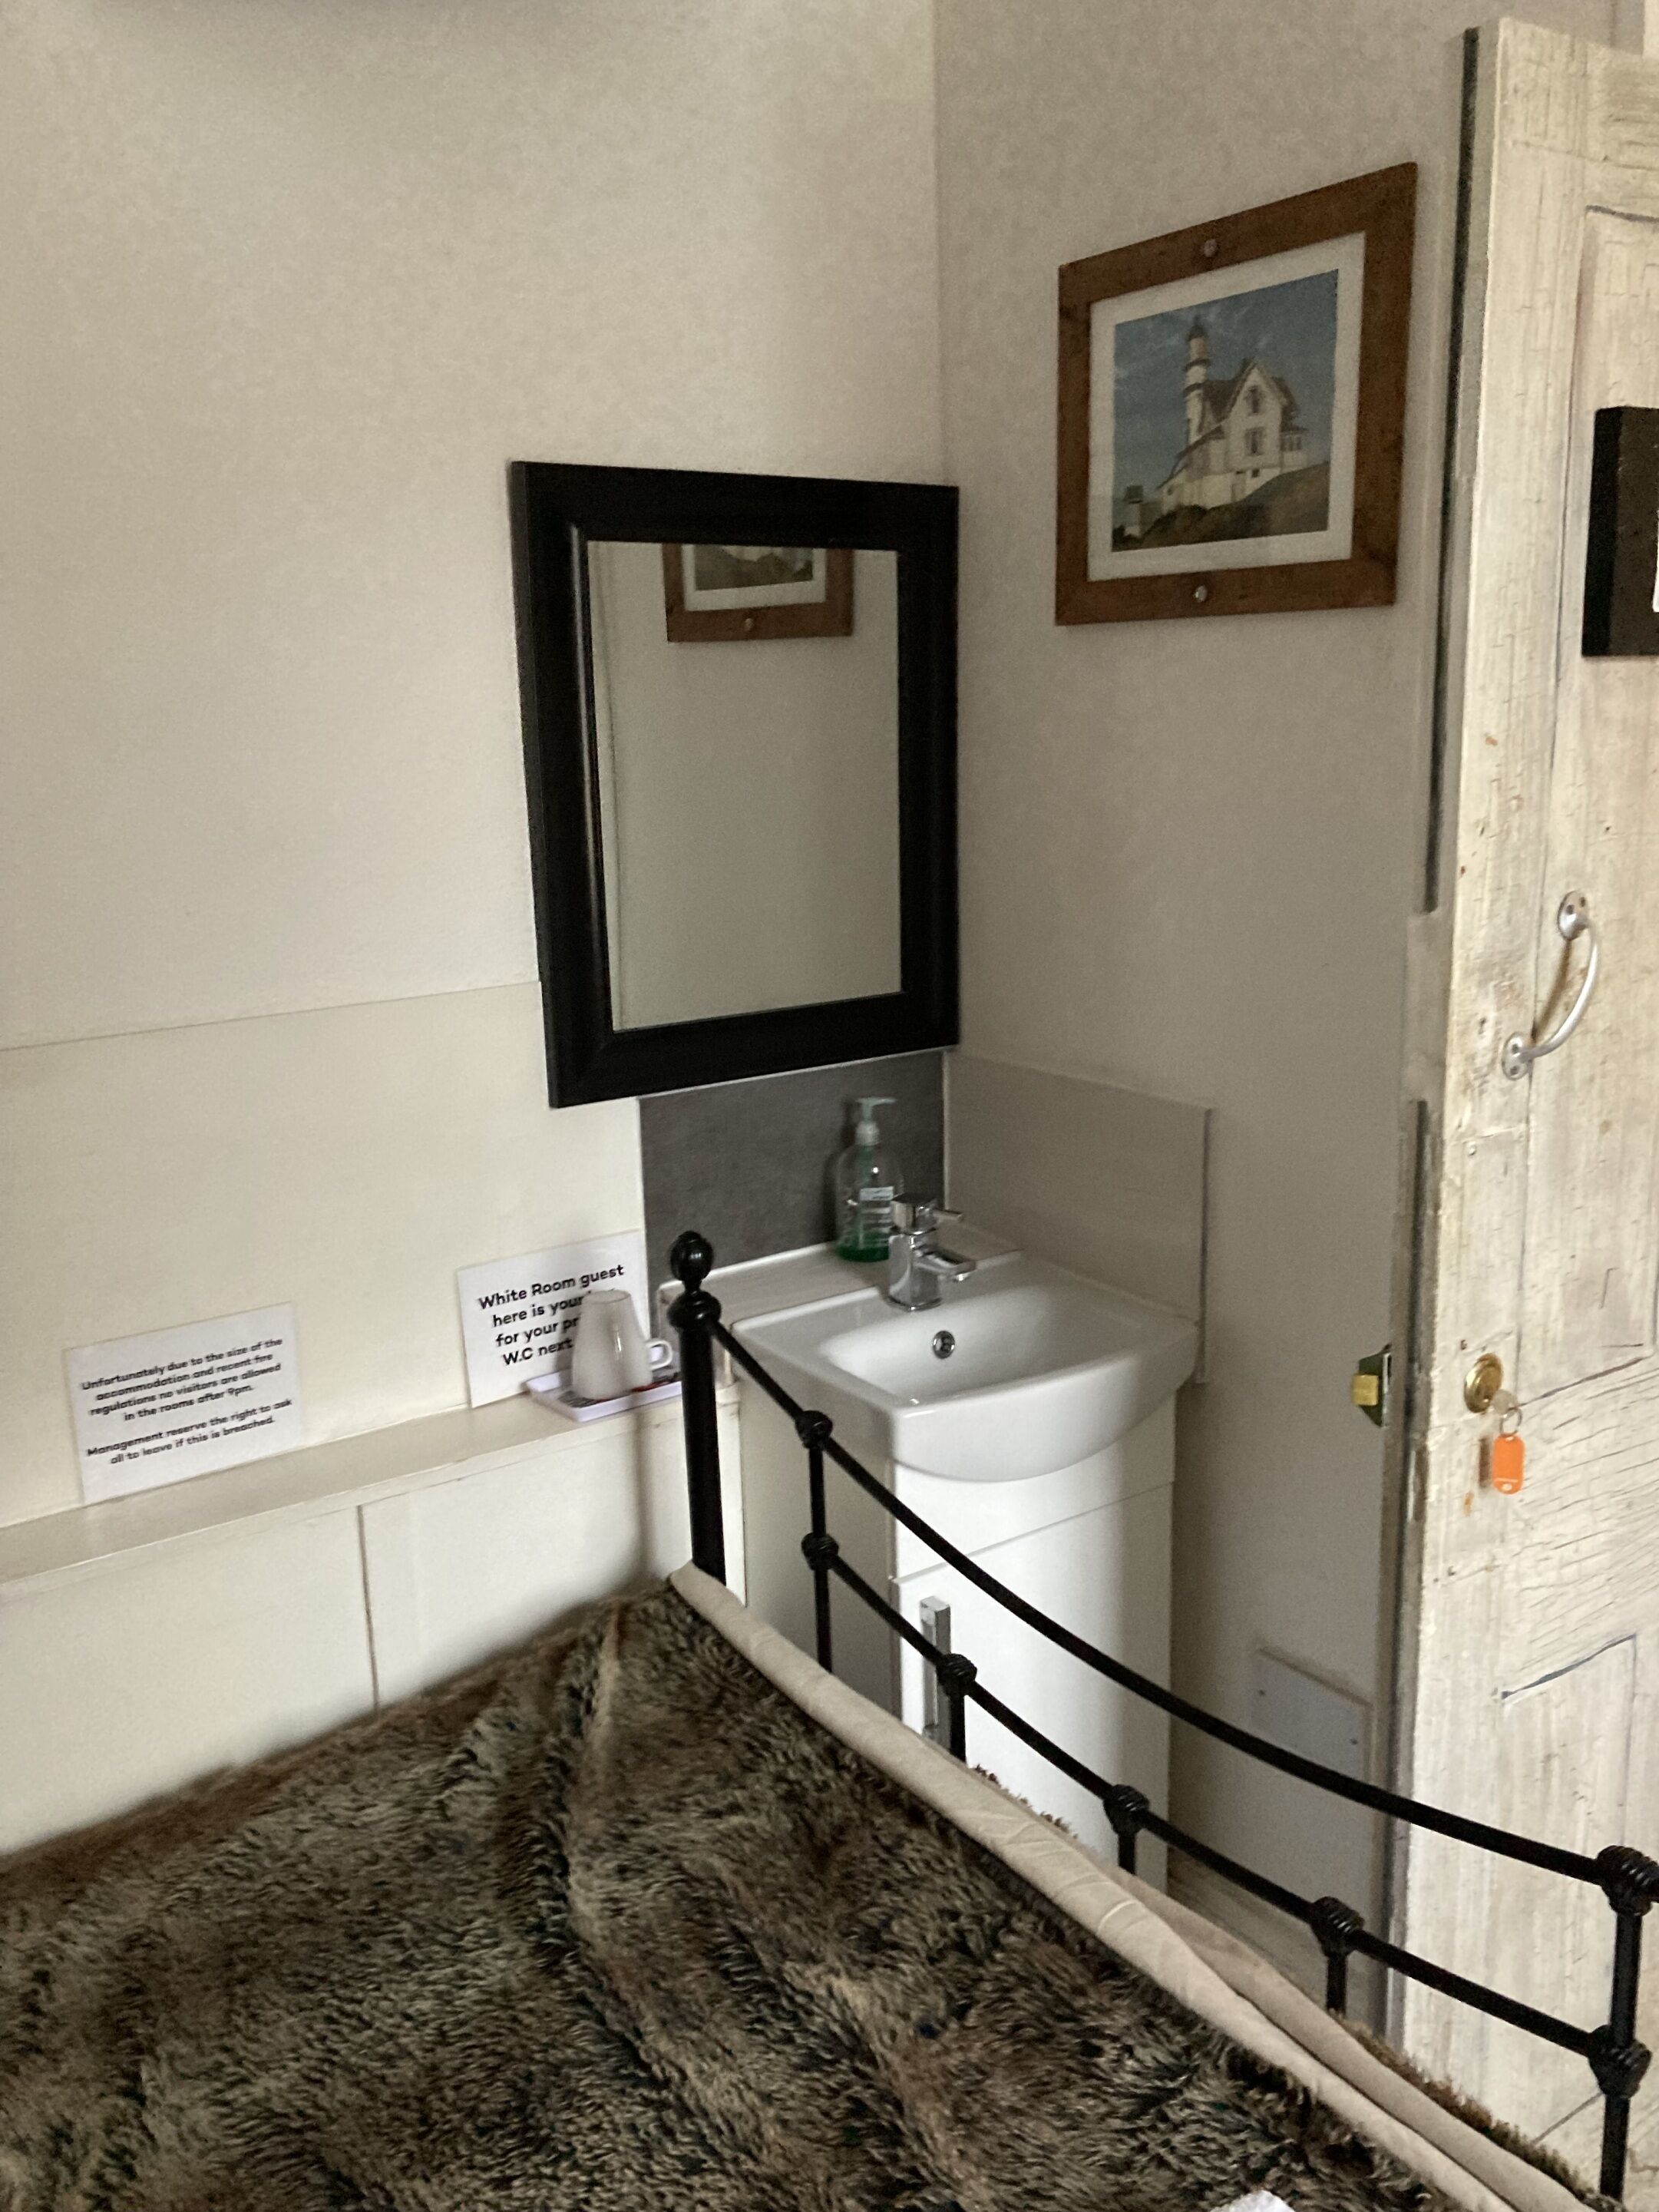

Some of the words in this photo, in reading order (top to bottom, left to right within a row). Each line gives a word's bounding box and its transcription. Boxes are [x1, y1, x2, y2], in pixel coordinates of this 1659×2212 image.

[479, 1290, 527, 1310] White
[531, 1277, 575, 1296] Room
[580, 1265, 624, 1288] guest
[493, 1311, 527, 1328] here
[532, 1304, 545, 1317] is
[547, 1295, 583, 1314] your
[496, 1333, 520, 1347] for
[524, 1322, 558, 1343] your
[503, 1347, 534, 1365] W.C
[538, 1337, 573, 1356] next
[82, 1366, 165, 1390] Unfortunately
[167, 1361, 188, 1371] due
[190, 1357, 203, 1366] to
[206, 1353, 224, 1362] the
[226, 1347, 247, 1357] size
[251, 1341, 263, 1351] of
[265, 1339, 283, 1347] the
[96, 1374, 190, 1400] accommodation
[193, 1367, 213, 1378] and
[216, 1358, 252, 1373] recent
[254, 1354, 273, 1363] fire
[90, 1394, 156, 1415] regulations
[159, 1390, 174, 1399] no
[177, 1381, 218, 1395] visitors
[220, 1376, 239, 1384] are
[241, 1363, 281, 1380] allowed
[137, 1407, 157, 1417] the
[160, 1399, 194, 1413] rooms
[197, 1392, 225, 1404] after
[227, 1385, 254, 1397] 9pm.
[87, 1432, 164, 1456] Management
[166, 1422, 207, 1437] reserve
[210, 1417, 229, 1426] the
[231, 1409, 258, 1422] right
[273, 1399, 292, 1409] ask
[110, 1453, 124, 1463] all
[143, 1443, 173, 1456] leave
[176, 1438, 183, 1447] if
[187, 1434, 208, 1444] this
[211, 1430, 220, 1439] is
[223, 1416, 276, 1435] breached.
